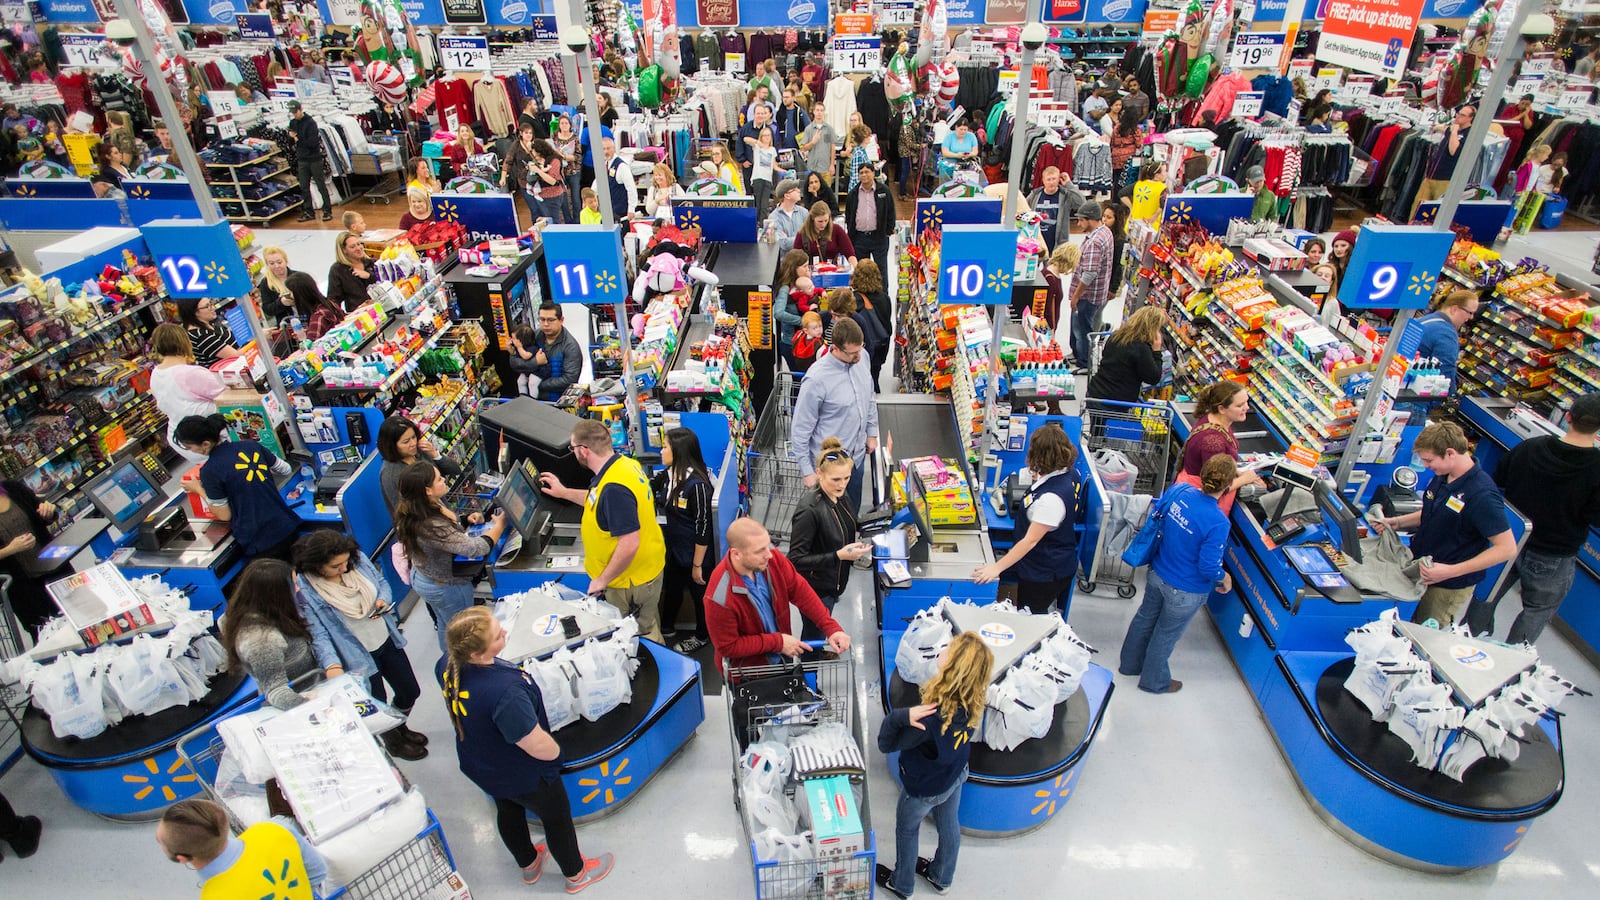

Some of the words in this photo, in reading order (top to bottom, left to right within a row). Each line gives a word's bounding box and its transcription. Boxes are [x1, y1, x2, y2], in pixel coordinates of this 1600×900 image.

[51, 2, 87, 13] Juniors
[706, 4, 732, 17] Glory
[1054, 0, 1078, 8] Hanes
[1329, 2, 1351, 20] FREE
[1347, 5, 1366, 24] pick
[1366, 11, 1378, 29] up
[1378, 11, 1389, 27] at
[1387, 12, 1413, 31] store
[844, 41, 856, 49] Low
[1324, 40, 1332, 49] Get
[1332, 42, 1340, 51] the
[1340, 44, 1358, 56] Walmart
[1357, 48, 1369, 59] App
[1368, 50, 1383, 63] today.
[473, 231, 504, 242] Price
[161, 256, 208, 291] 12
[554, 264, 589, 296] 11
[946, 264, 984, 297] 10
[1369, 265, 1398, 300] 9
